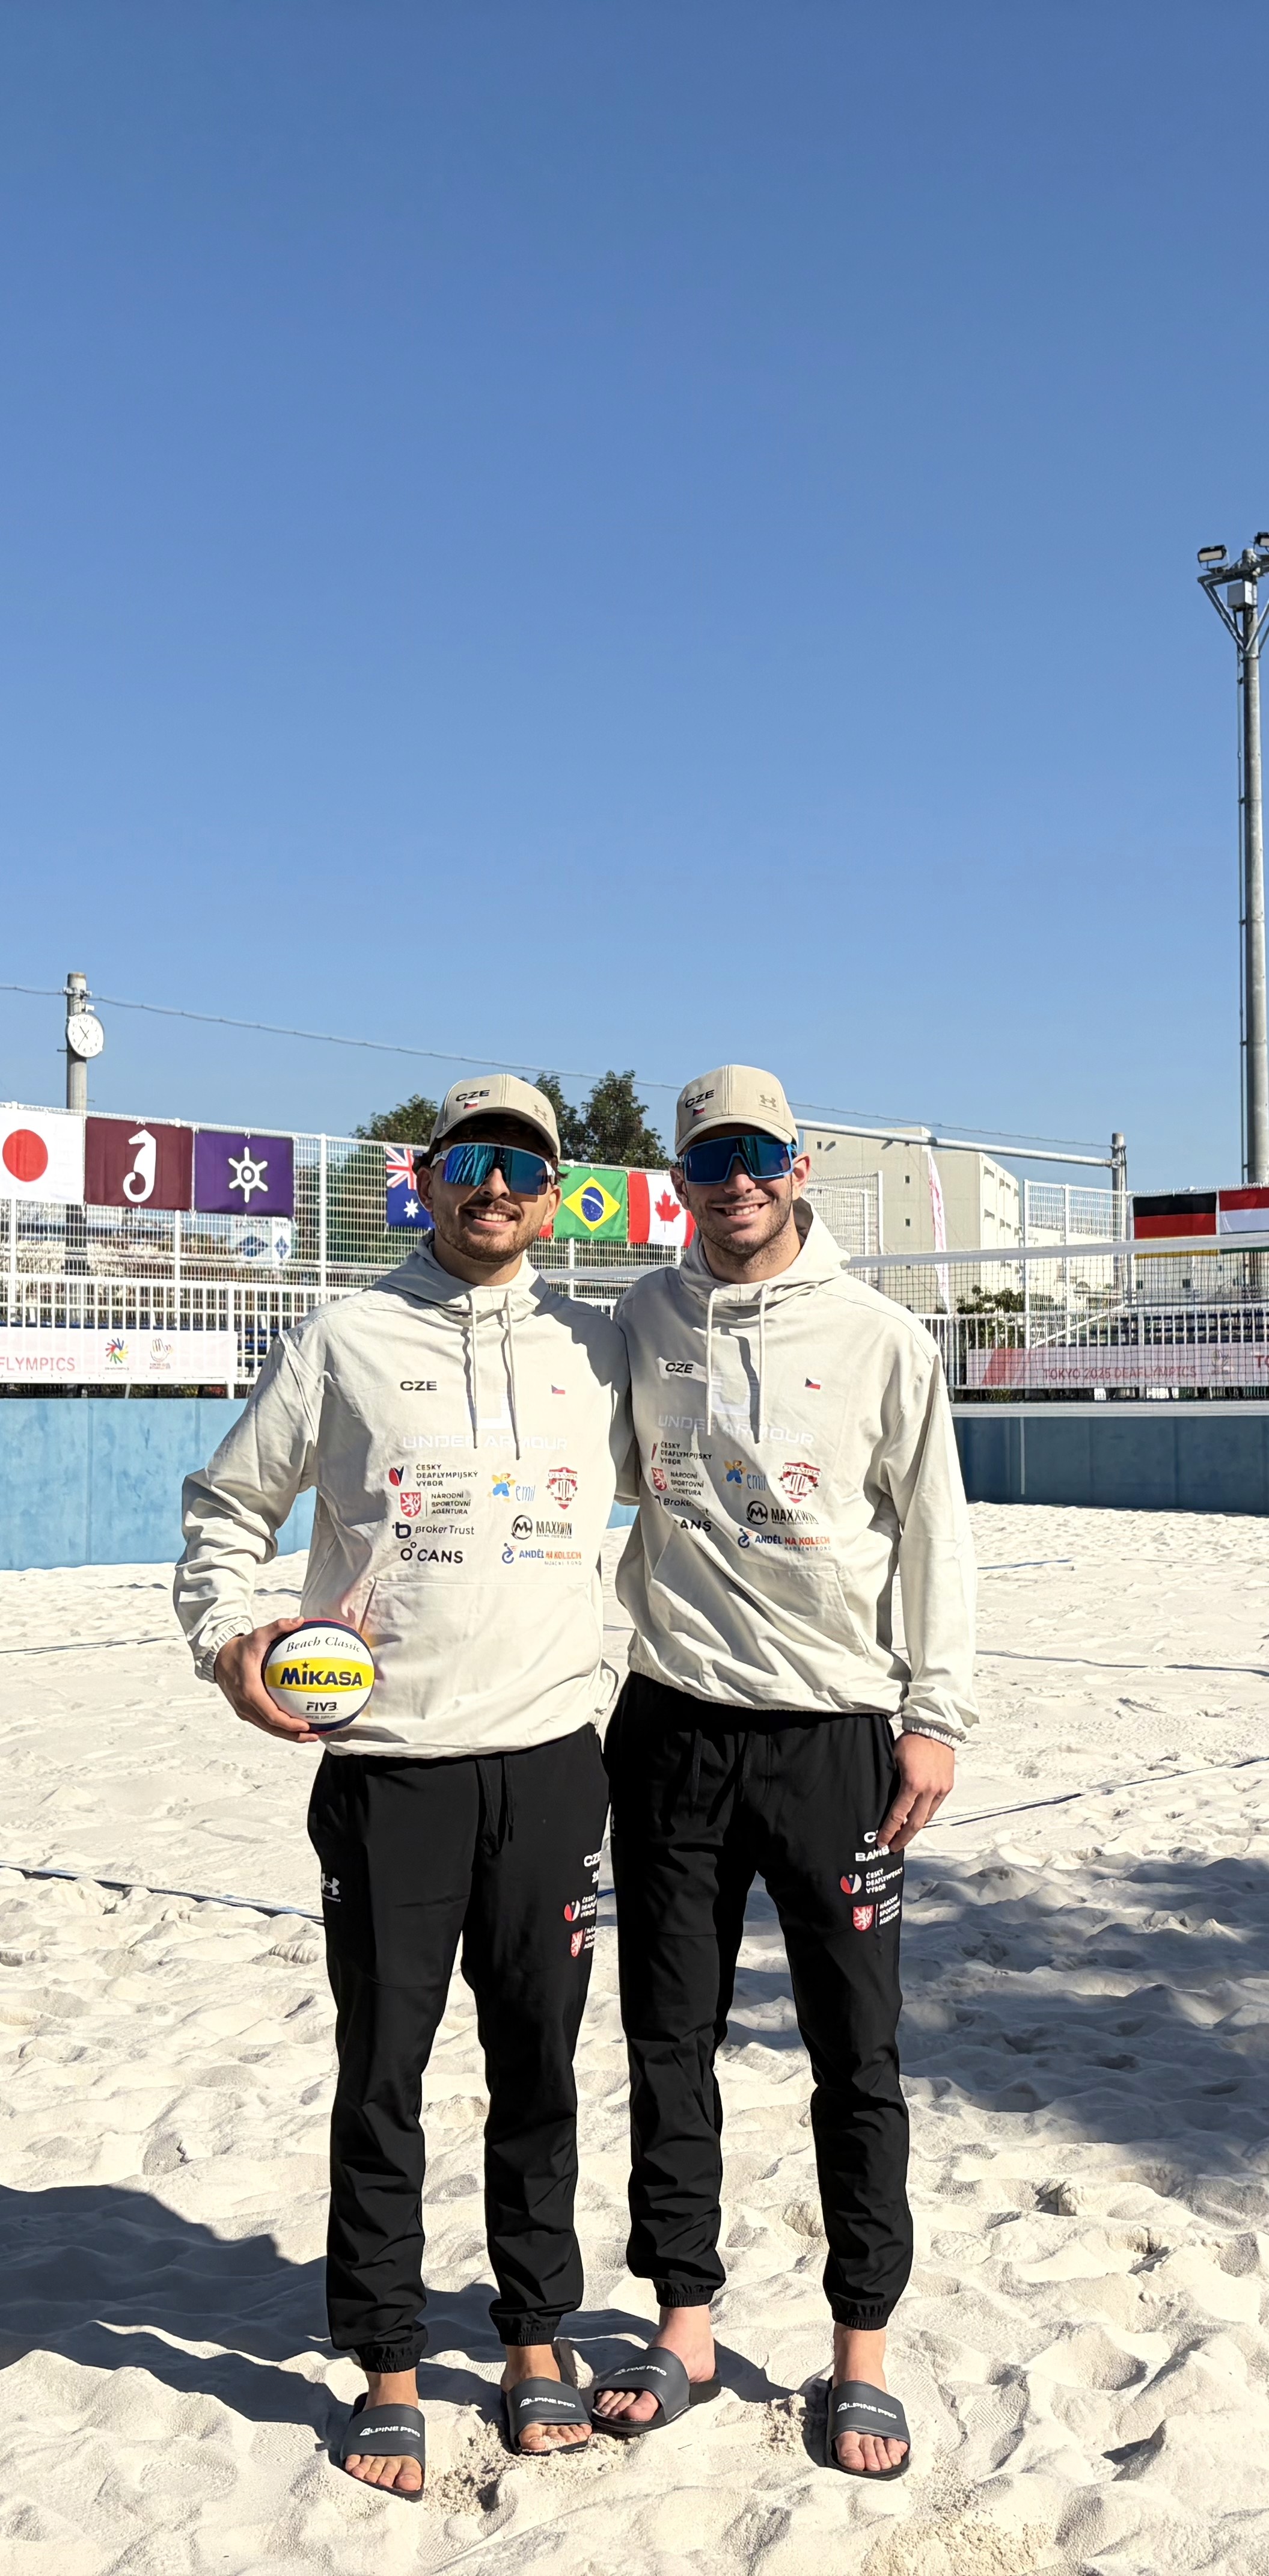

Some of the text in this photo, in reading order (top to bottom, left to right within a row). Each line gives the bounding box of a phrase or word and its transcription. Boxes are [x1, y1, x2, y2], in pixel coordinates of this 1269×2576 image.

[456, 1090, 491, 1102] CZE
[685, 1090, 715, 1108] CZE
[665, 1362, 694, 1374] CZE
[1043, 1368, 1080, 1379] TOKYO
[1083, 1367, 1112, 1379] 2025
[400, 1381, 438, 1391] CZE
[416, 1471, 478, 1479] DEAFLYMPIJSKÝ
[516, 1485, 536, 1501] emil
[784, 1536, 797, 1545] NA
[798, 1536, 831, 1546] KOLECH
[286, 1636, 361, 1653] Beach Classic
[306, 1702, 337, 1712] FIVB
[646, 2365, 667, 2376] PRO
[837, 2402, 897, 2419] ALPINE PRO
[359, 2426, 420, 2438] ALPINE PRO
